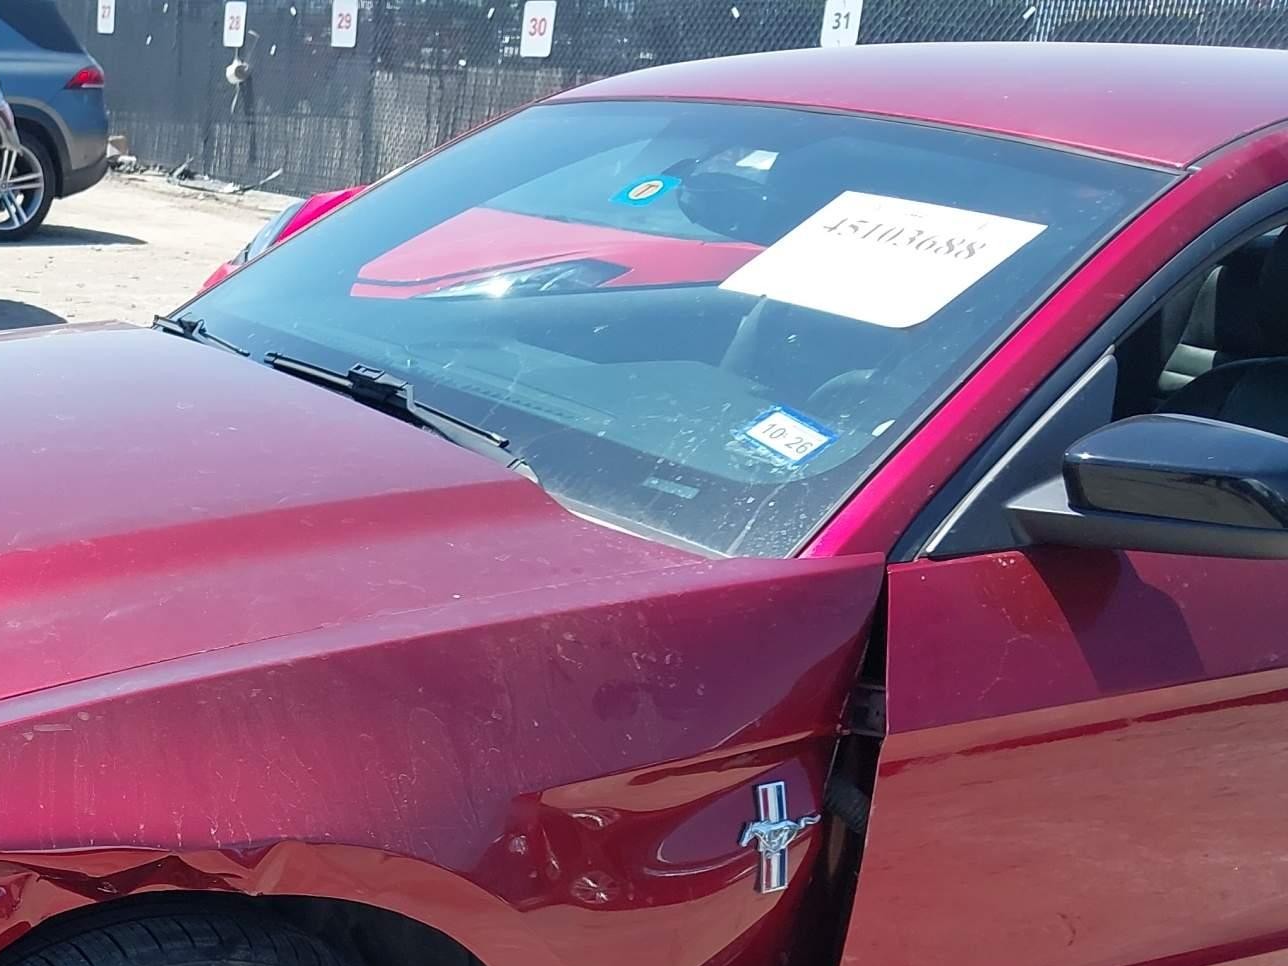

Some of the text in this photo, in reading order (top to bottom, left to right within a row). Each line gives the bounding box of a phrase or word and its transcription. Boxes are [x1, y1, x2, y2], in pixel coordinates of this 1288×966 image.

[100, 5, 112, 19] 27
[228, 16, 242, 31] 28
[337, 13, 352, 29] 29
[528, 17, 547, 36] 30
[832, 12, 851, 30] 31
[822, 217, 987, 260] 45103688
